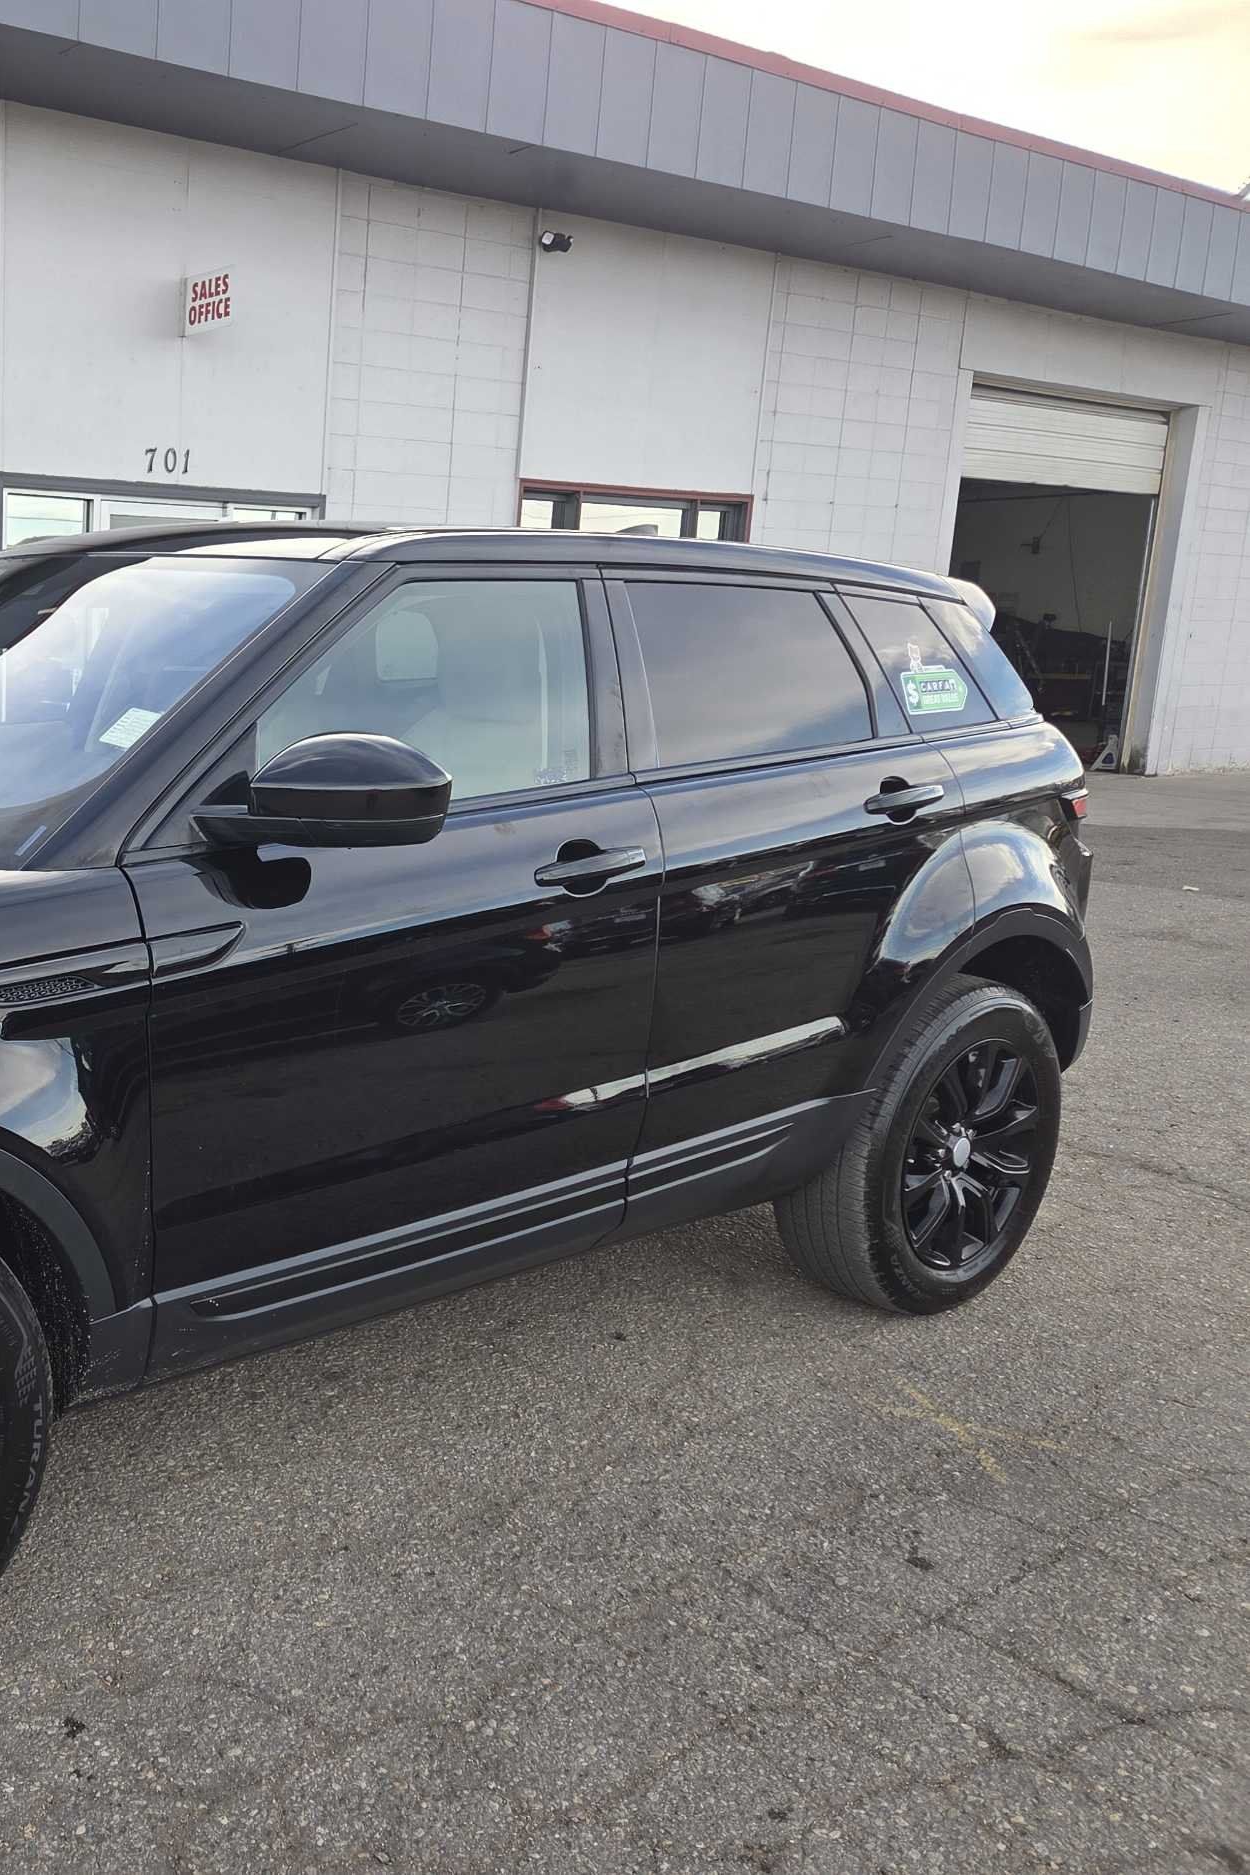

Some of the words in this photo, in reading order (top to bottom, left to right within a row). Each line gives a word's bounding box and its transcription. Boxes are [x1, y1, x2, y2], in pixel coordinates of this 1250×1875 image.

[191, 273, 230, 303] SALES
[188, 297, 232, 326] OFFICE
[145, 447, 190, 474] 701
